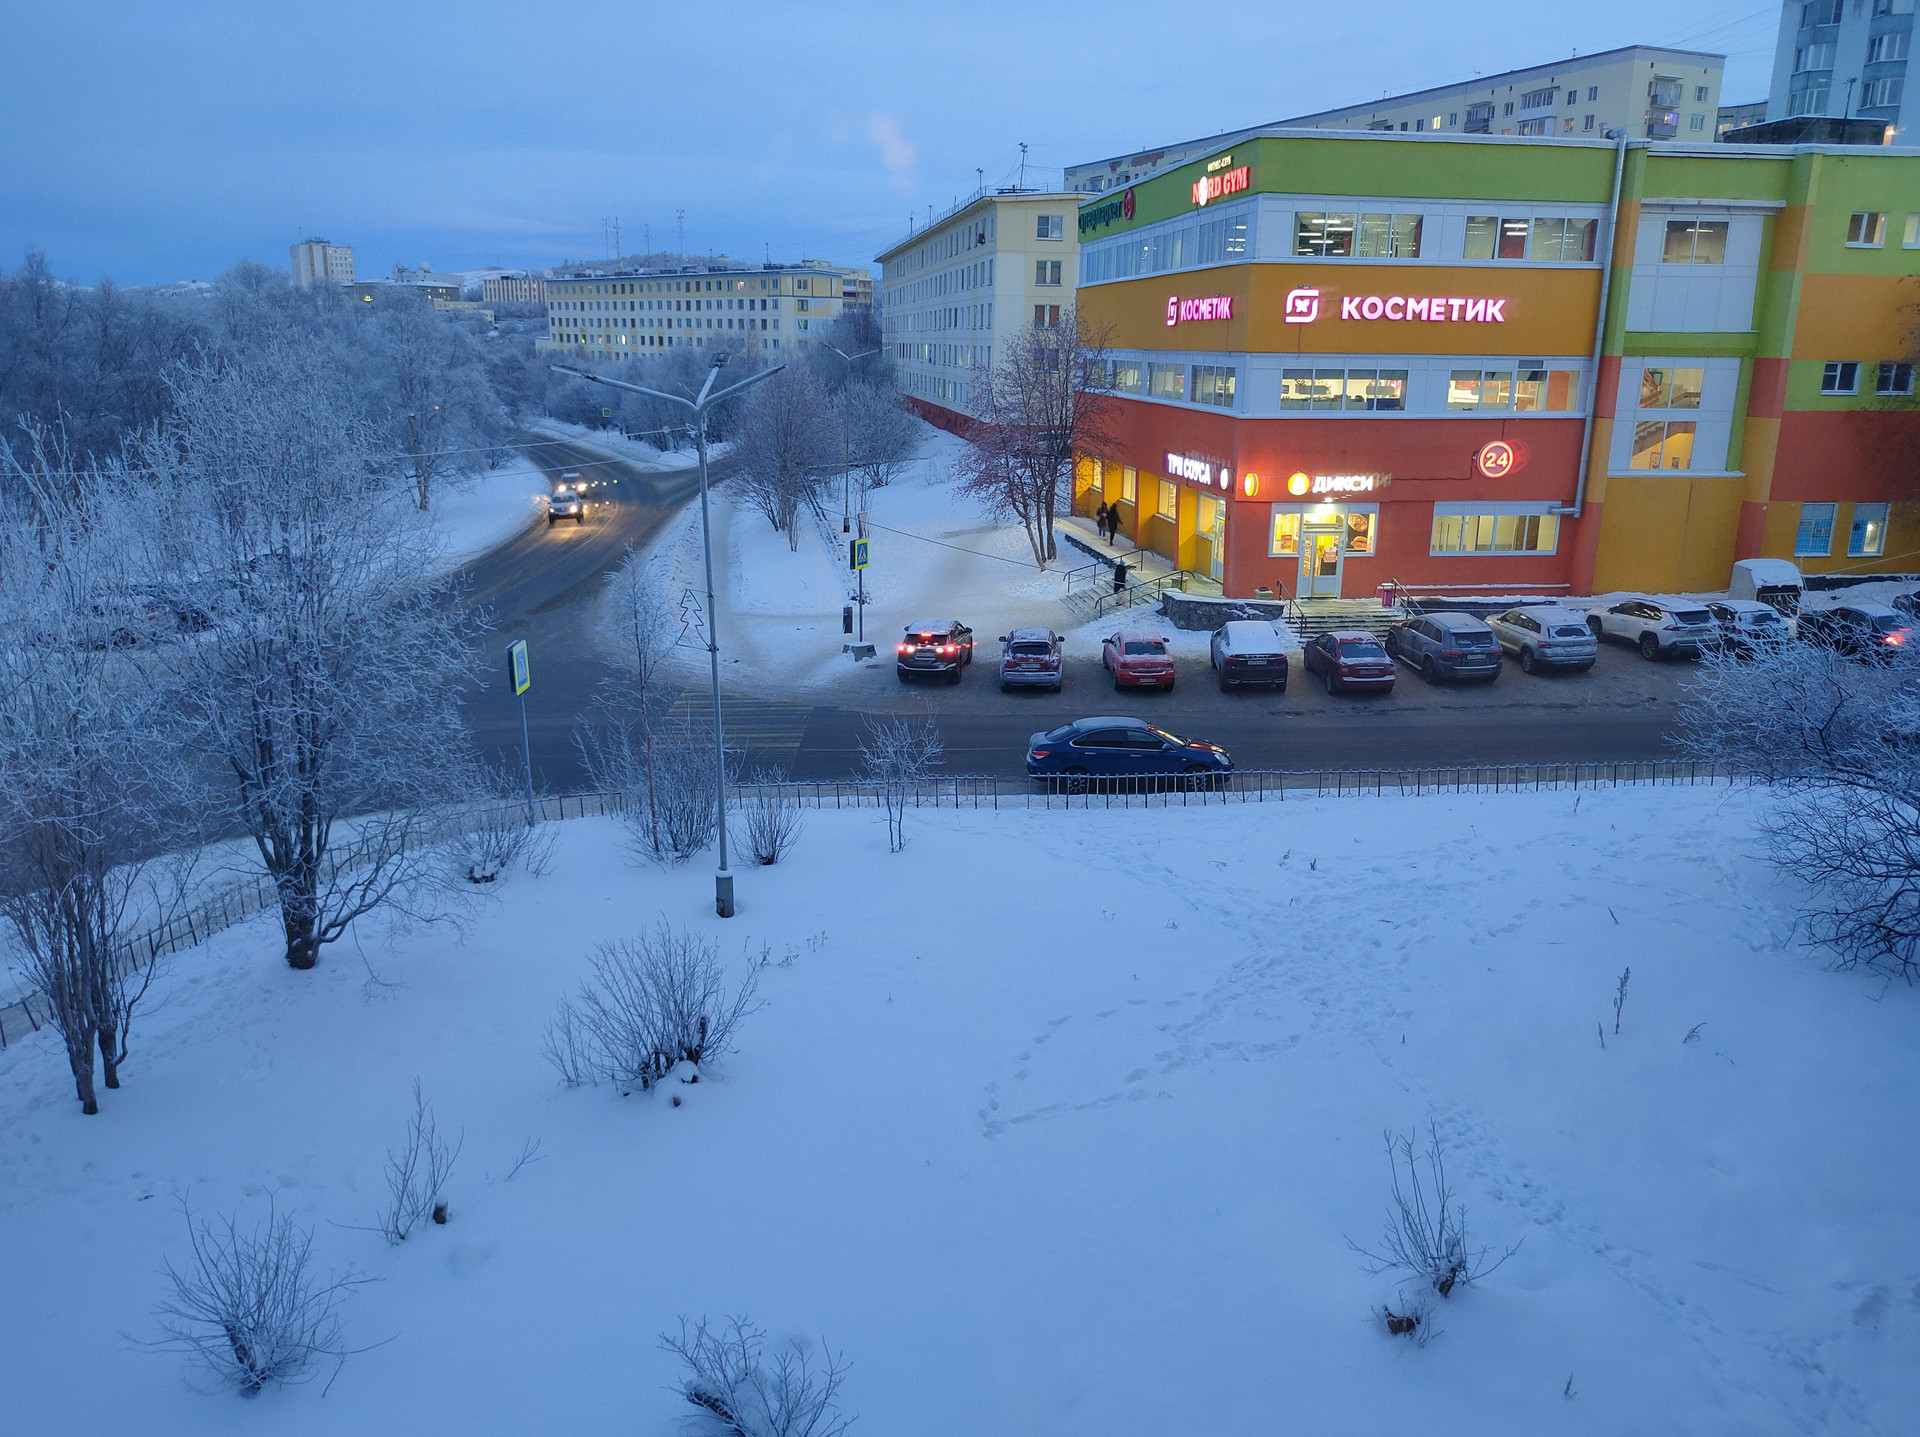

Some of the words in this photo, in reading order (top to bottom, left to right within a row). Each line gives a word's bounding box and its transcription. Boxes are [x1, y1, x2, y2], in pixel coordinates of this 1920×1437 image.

[1192, 175, 1222, 206] NORD
[1223, 166, 1249, 195] GYM
[1180, 296, 1232, 322] КОСМЕТИК
[1340, 296, 1506, 322] КОСМЕТИК
[1167, 452, 1184, 477] ТРИ
[1183, 458, 1211, 485] СОУСА
[1484, 452, 1508, 468] 24
[1312, 475, 1374, 494] ДИКСИ
